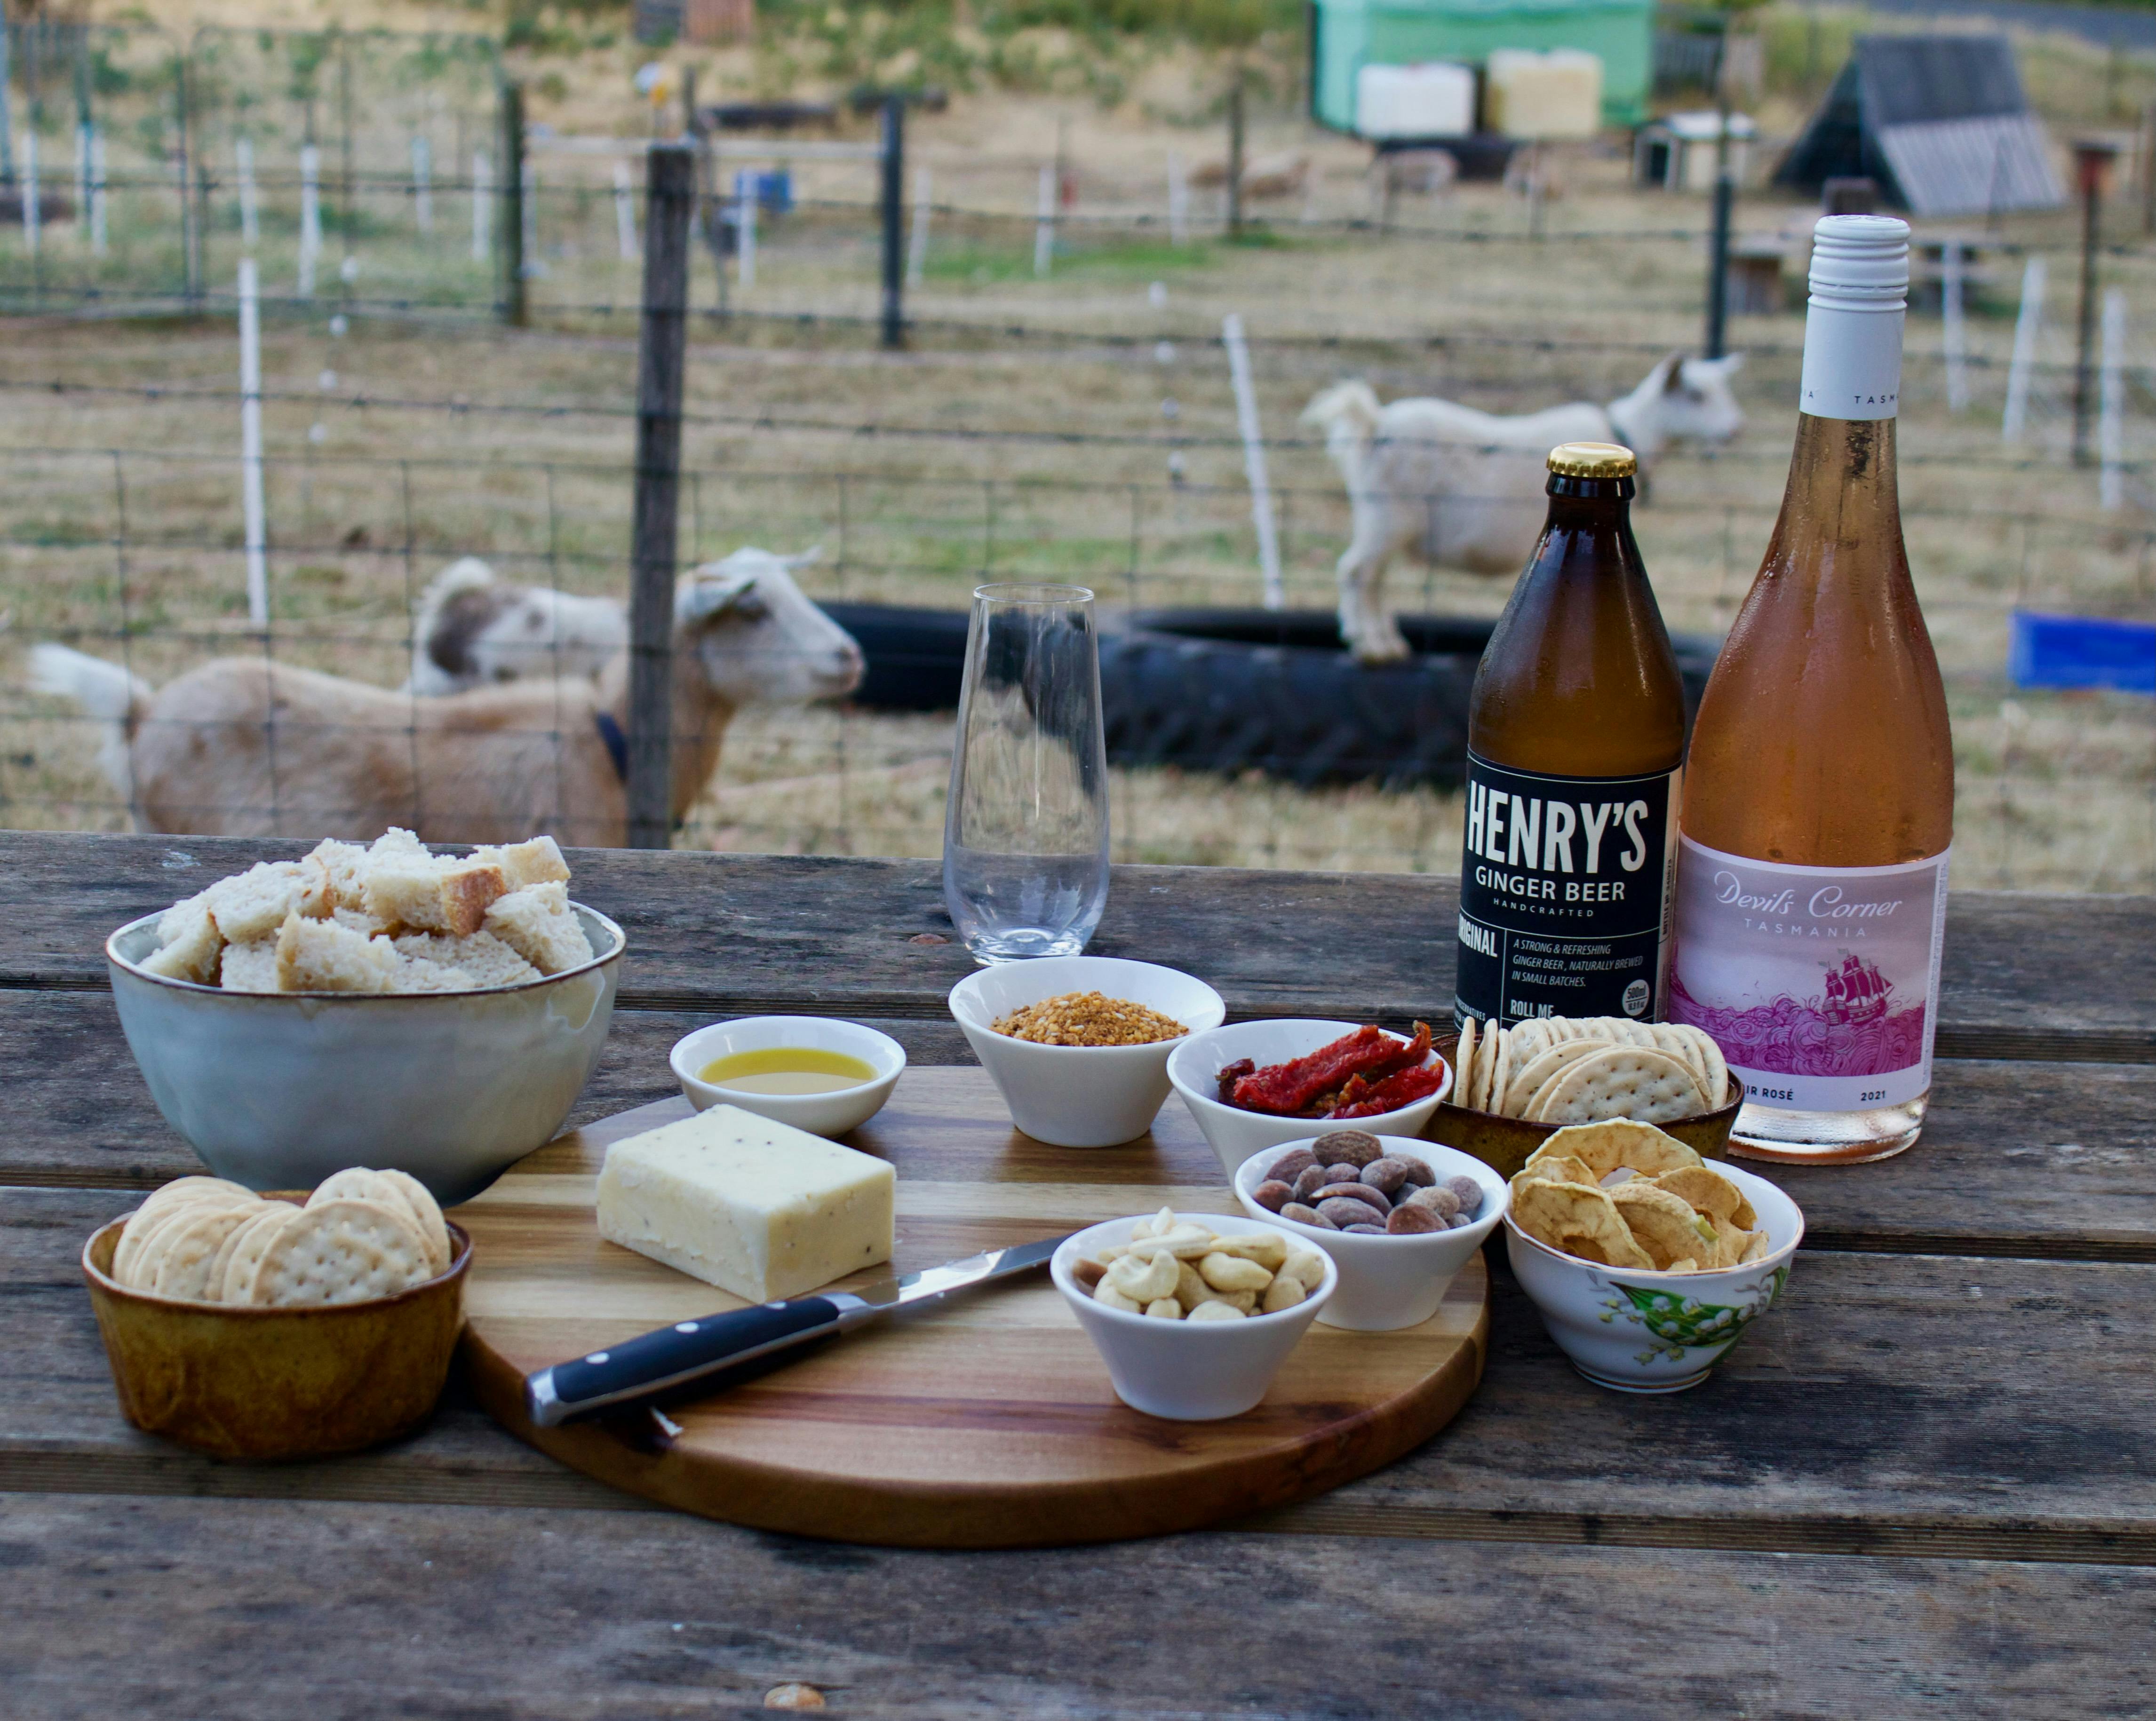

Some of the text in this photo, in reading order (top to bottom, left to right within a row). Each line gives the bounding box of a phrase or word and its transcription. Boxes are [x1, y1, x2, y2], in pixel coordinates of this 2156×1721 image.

[1854, 394, 1898, 404] TASM
[1468, 780, 1648, 873] HENRY'S
[1476, 865, 1625, 902] GINGER BEER
[1714, 871, 1795, 915] Devil's
[1808, 886, 1903, 918] Corner
[1494, 897, 1594, 917] HANDCRAFTED
[1458, 912, 1498, 958] RIGINAL
[1744, 918, 1866, 937] TASMANIA
[1513, 939, 1611, 955] A STRONG & REFRESHING
[1513, 954, 1542, 968] GINGER
[1569, 960, 1615, 971] NATURALLY
[1615, 956, 1644, 969] BREWED
[1512, 970, 1586, 987] IN SMALL BATCHES.
[1510, 999, 1535, 1018] ROLL
[1746, 1085, 1794, 1101] IR ROSÉ
[1861, 1090, 1886, 1101] 2021
